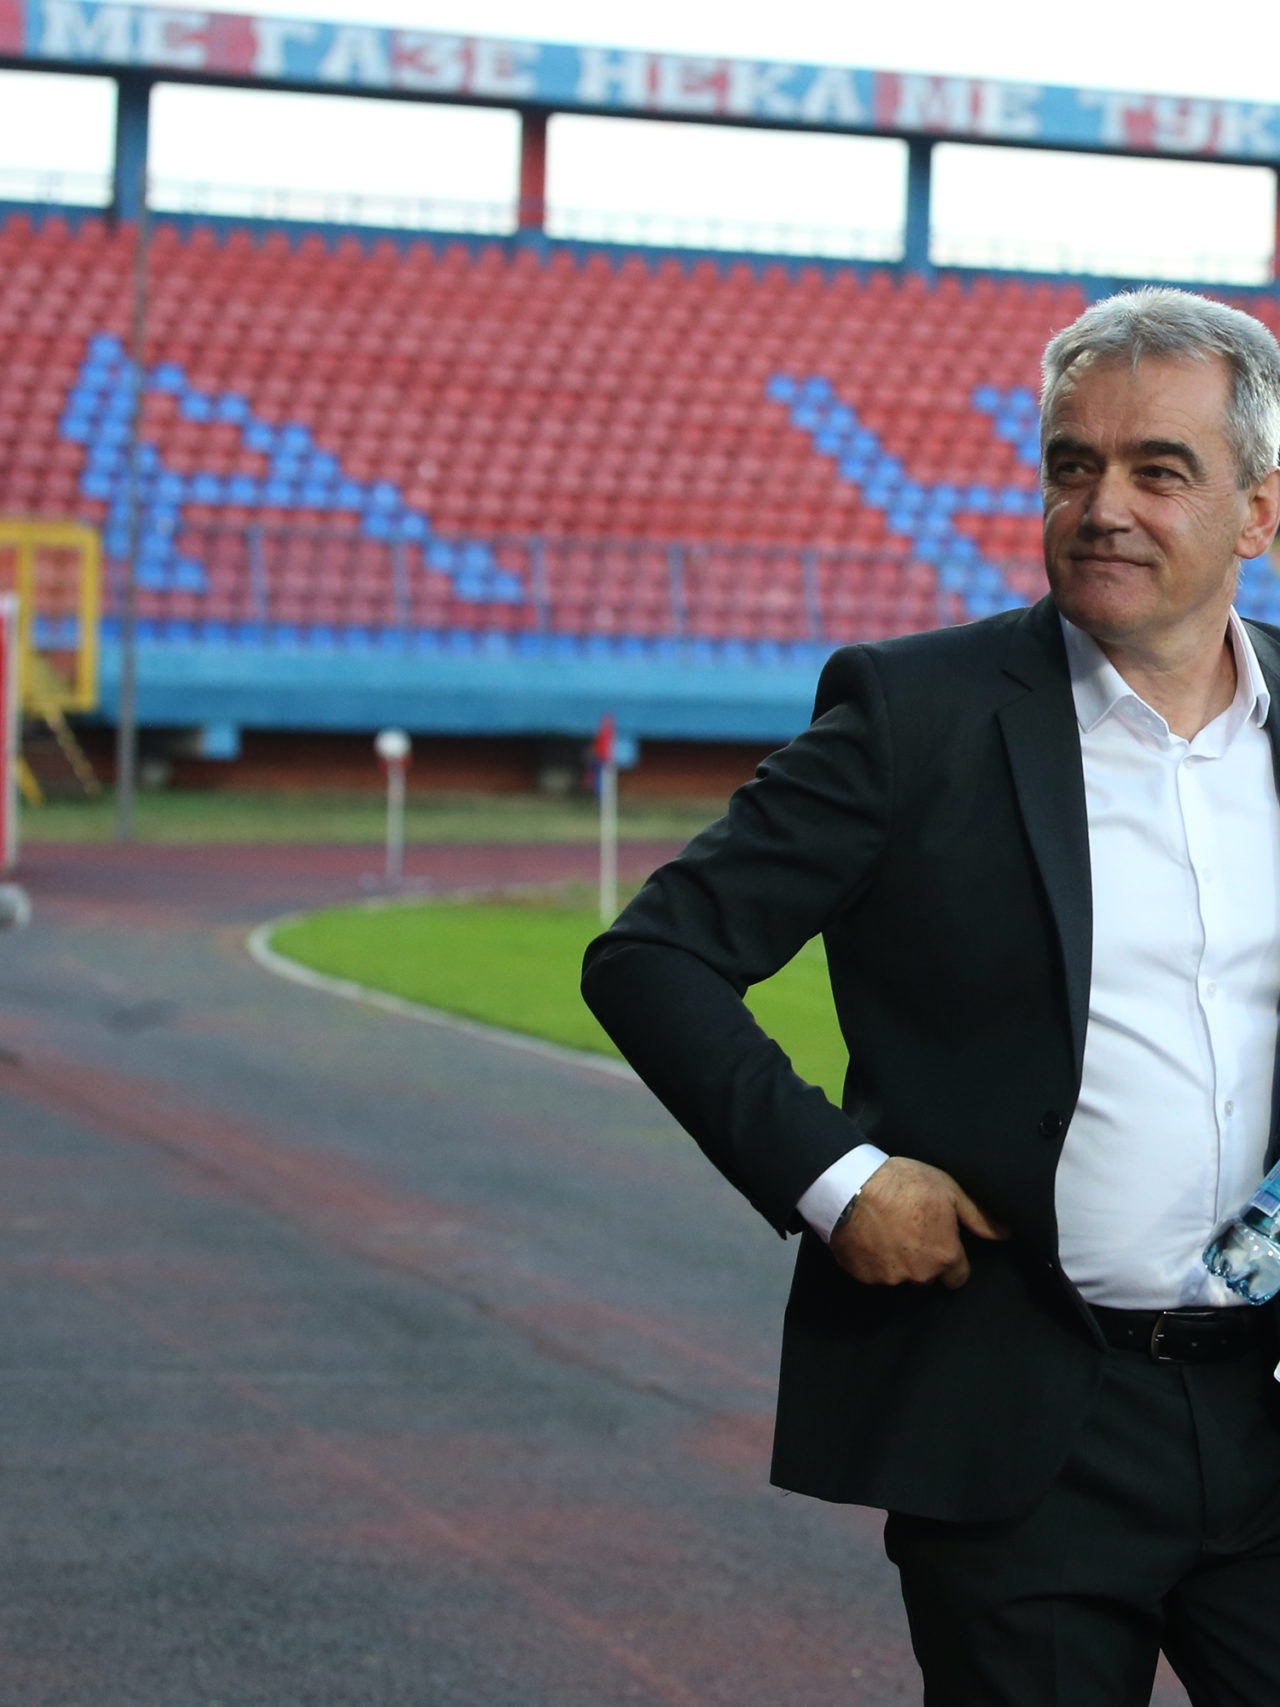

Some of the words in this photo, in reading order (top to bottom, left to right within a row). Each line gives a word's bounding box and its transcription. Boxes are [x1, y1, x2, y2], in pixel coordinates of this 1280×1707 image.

[39, 2, 209, 66] МЕ
[252, 15, 542, 98] ГАЗЕ
[576, 48, 870, 125] НЕКА
[892, 71, 1046, 138] МЕ
